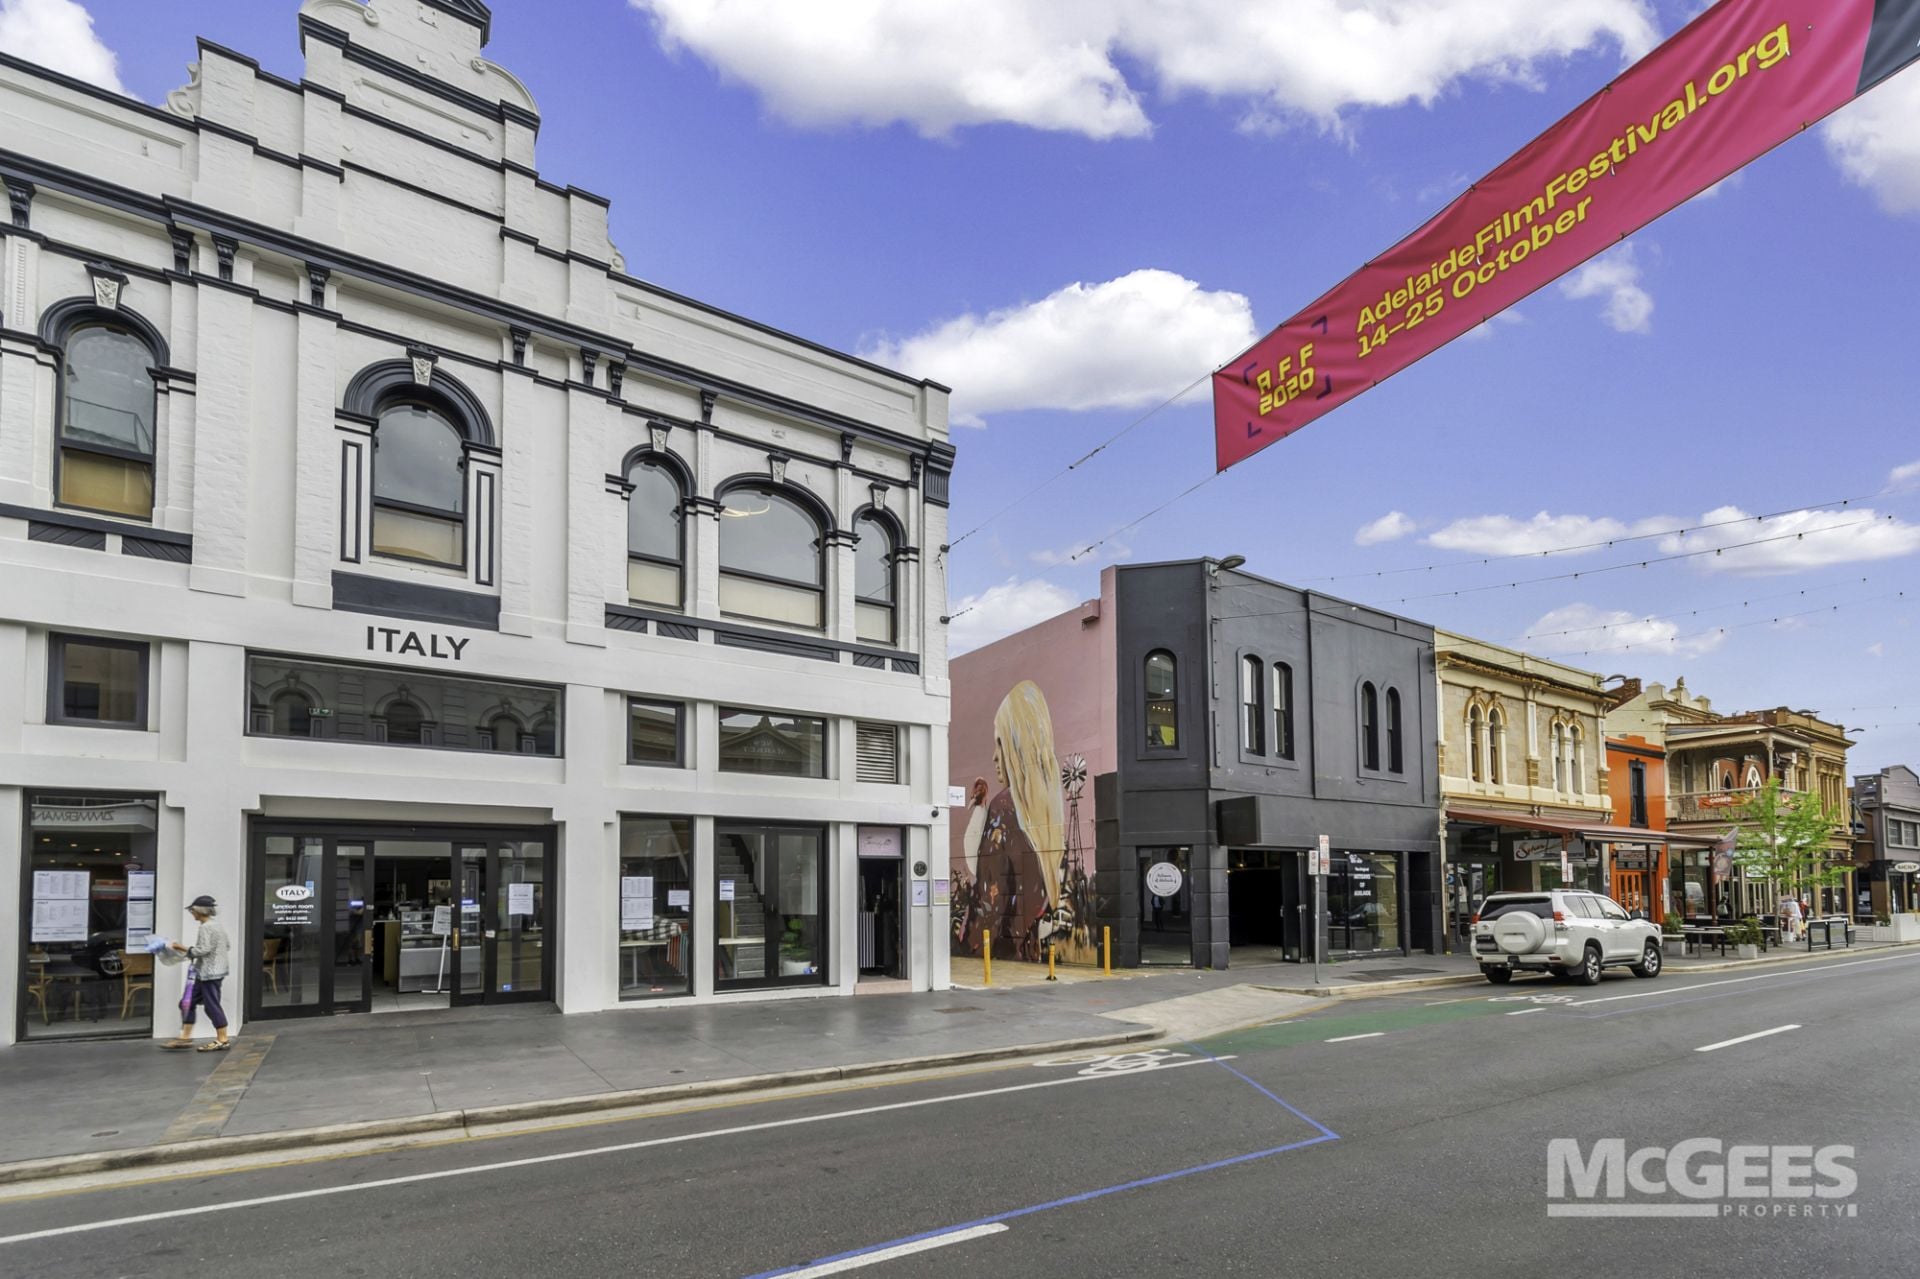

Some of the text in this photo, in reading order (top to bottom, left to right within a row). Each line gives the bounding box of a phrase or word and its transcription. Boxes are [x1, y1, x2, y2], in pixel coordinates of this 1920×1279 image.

[1357, 23, 1790, 333] AdelaideFilmFestival.org
[1452, 196, 1592, 298] October
[1260, 367, 1314, 416] 2020
[367, 626, 470, 660] ITALY
